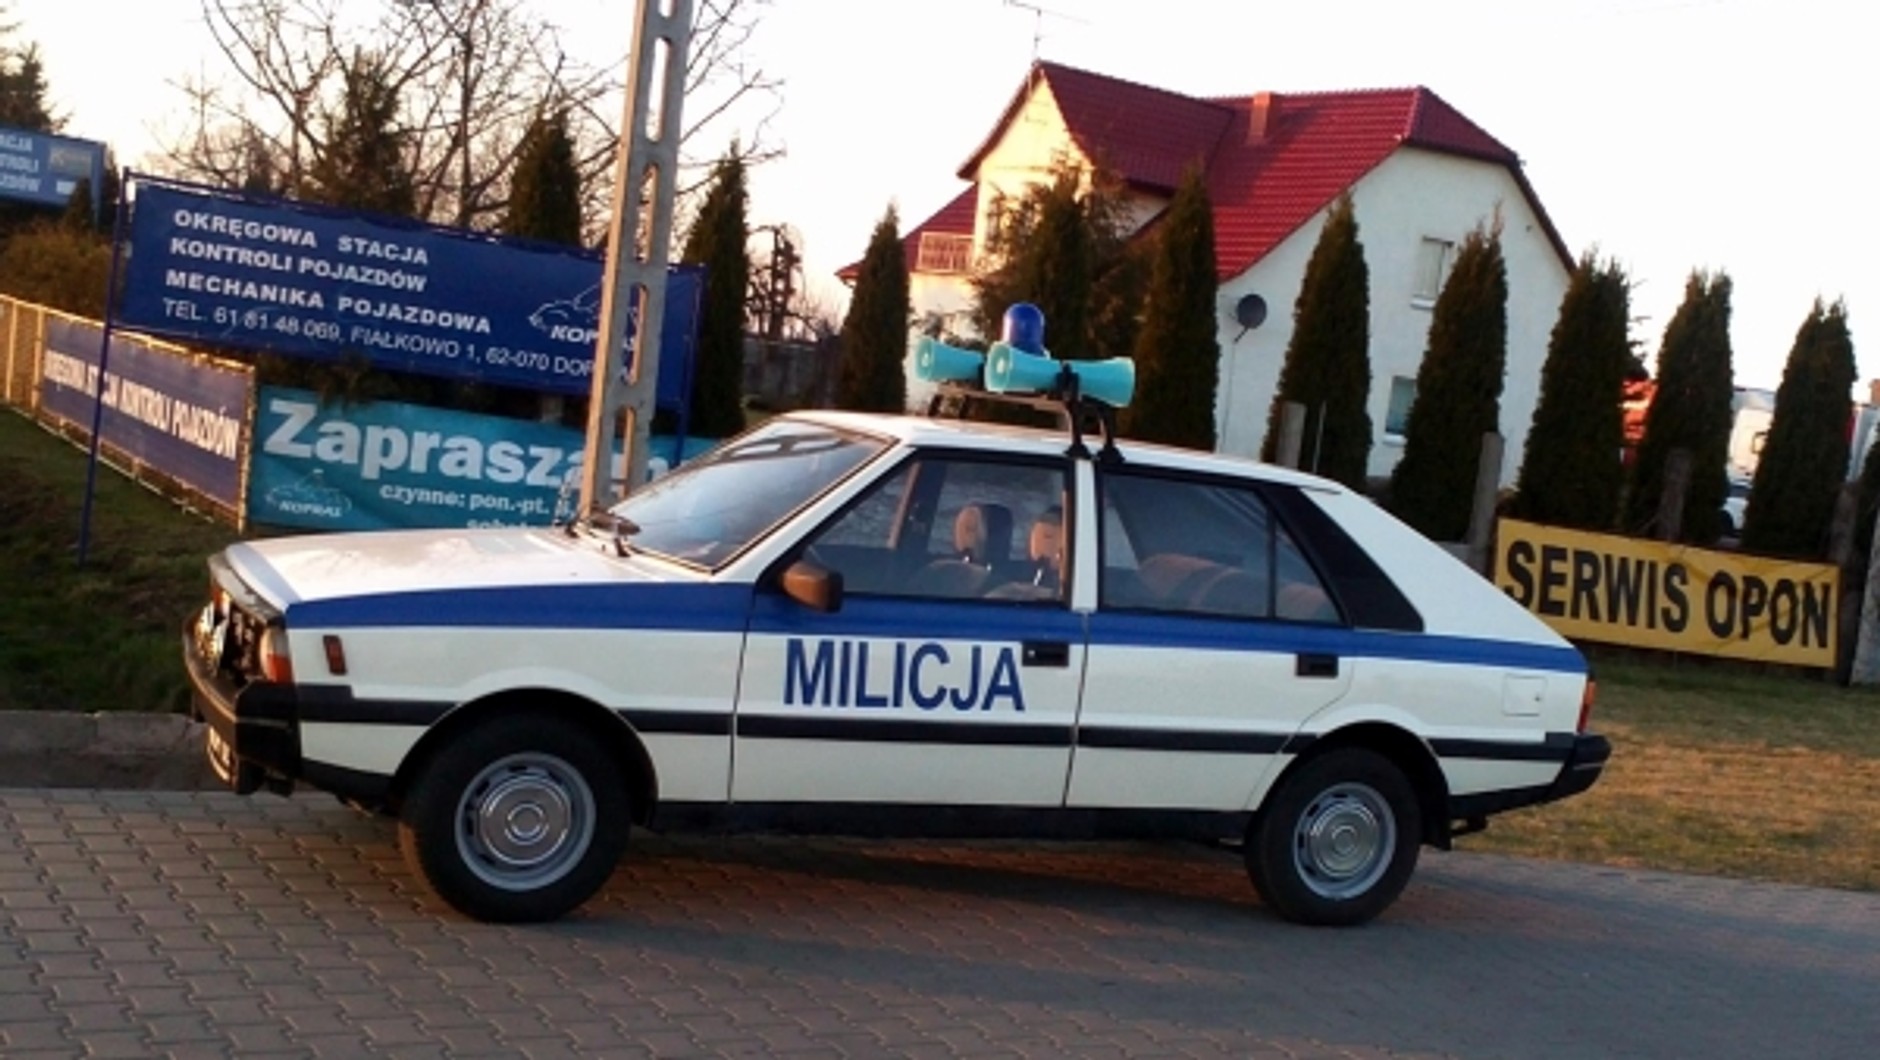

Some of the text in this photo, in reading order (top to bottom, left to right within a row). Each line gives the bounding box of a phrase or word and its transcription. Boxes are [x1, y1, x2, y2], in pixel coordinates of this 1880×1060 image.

[170, 237, 427, 292] KONTROLI POJAZDÓW
[173, 209, 428, 265] OKRĘGOWA STACJA
[163, 297, 206, 321] TEL.
[213, 306, 238, 326] 61
[351, 325, 460, 358] FIAŁKOWO
[485, 347, 550, 371] 62-070
[165, 269, 491, 334] MECHANIKA POJAZDOWA
[1503, 540, 1830, 650] SERWIS OPON
[783, 638, 1025, 711] MILICJA
